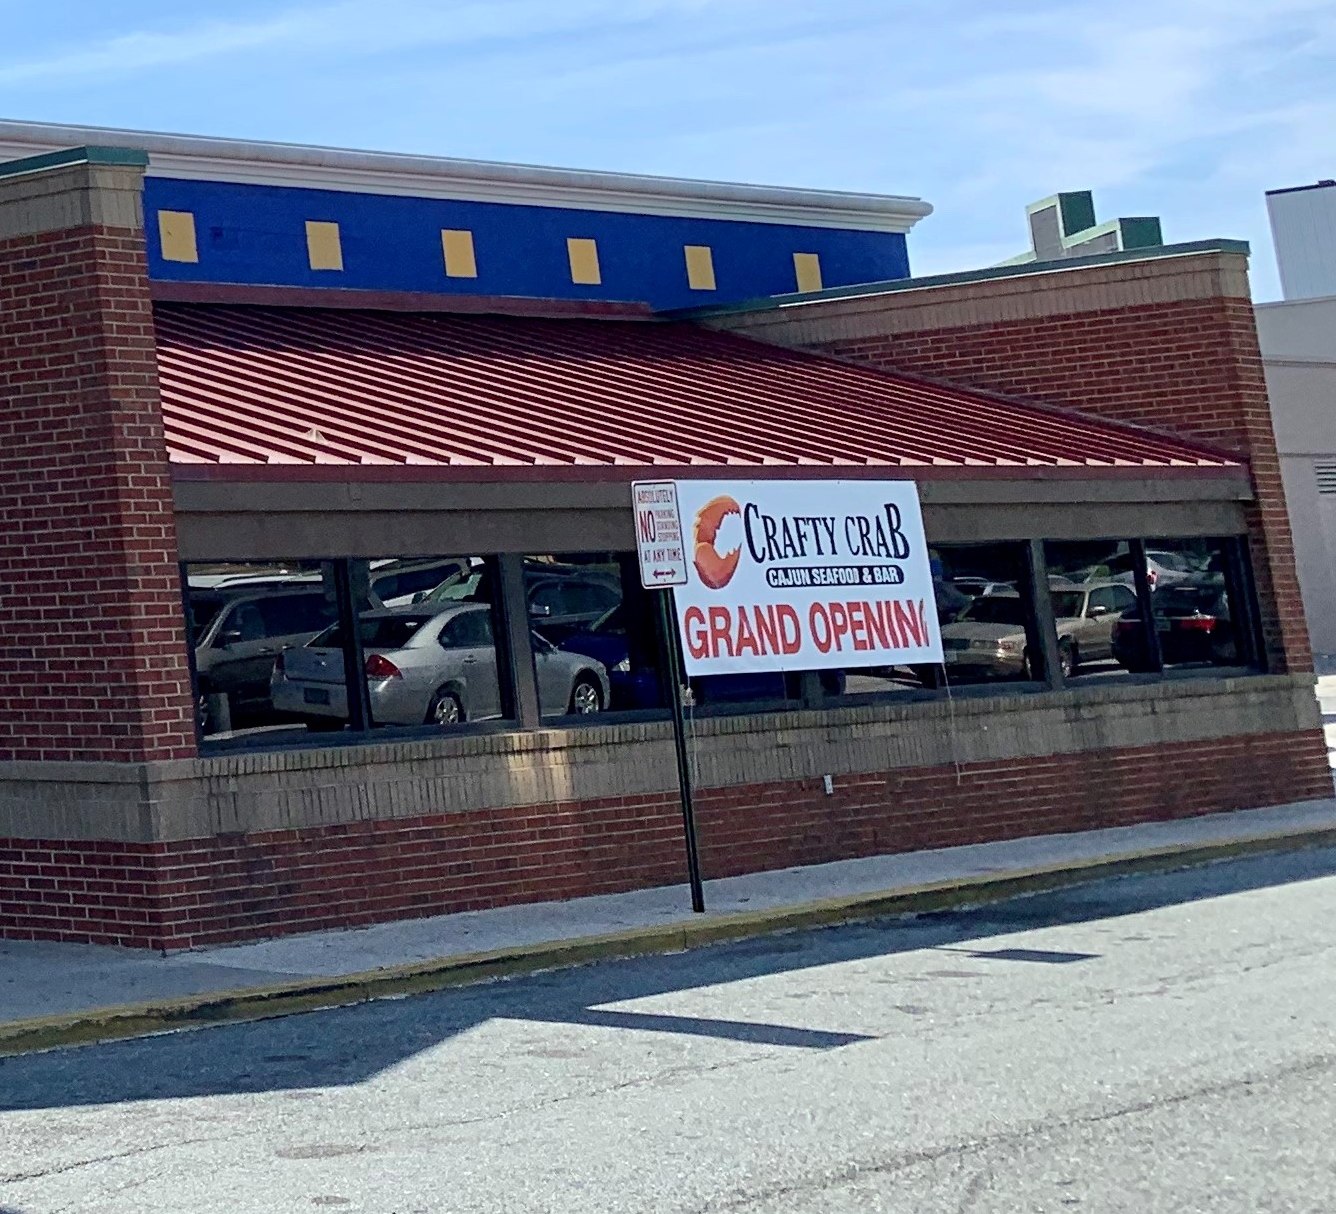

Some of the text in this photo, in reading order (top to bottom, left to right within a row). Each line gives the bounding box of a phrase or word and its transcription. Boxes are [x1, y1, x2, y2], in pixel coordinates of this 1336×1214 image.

[637, 489, 674, 504] ABSOLUTELY
[639, 510, 656, 543] NO
[743, 502, 910, 563] CRAFTY CRAB
[644, 547, 683, 563] AT ANY TIME
[768, 566, 900, 586] CAJUN SEAFOOD & BAR
[684, 604, 801, 660] GRAND
